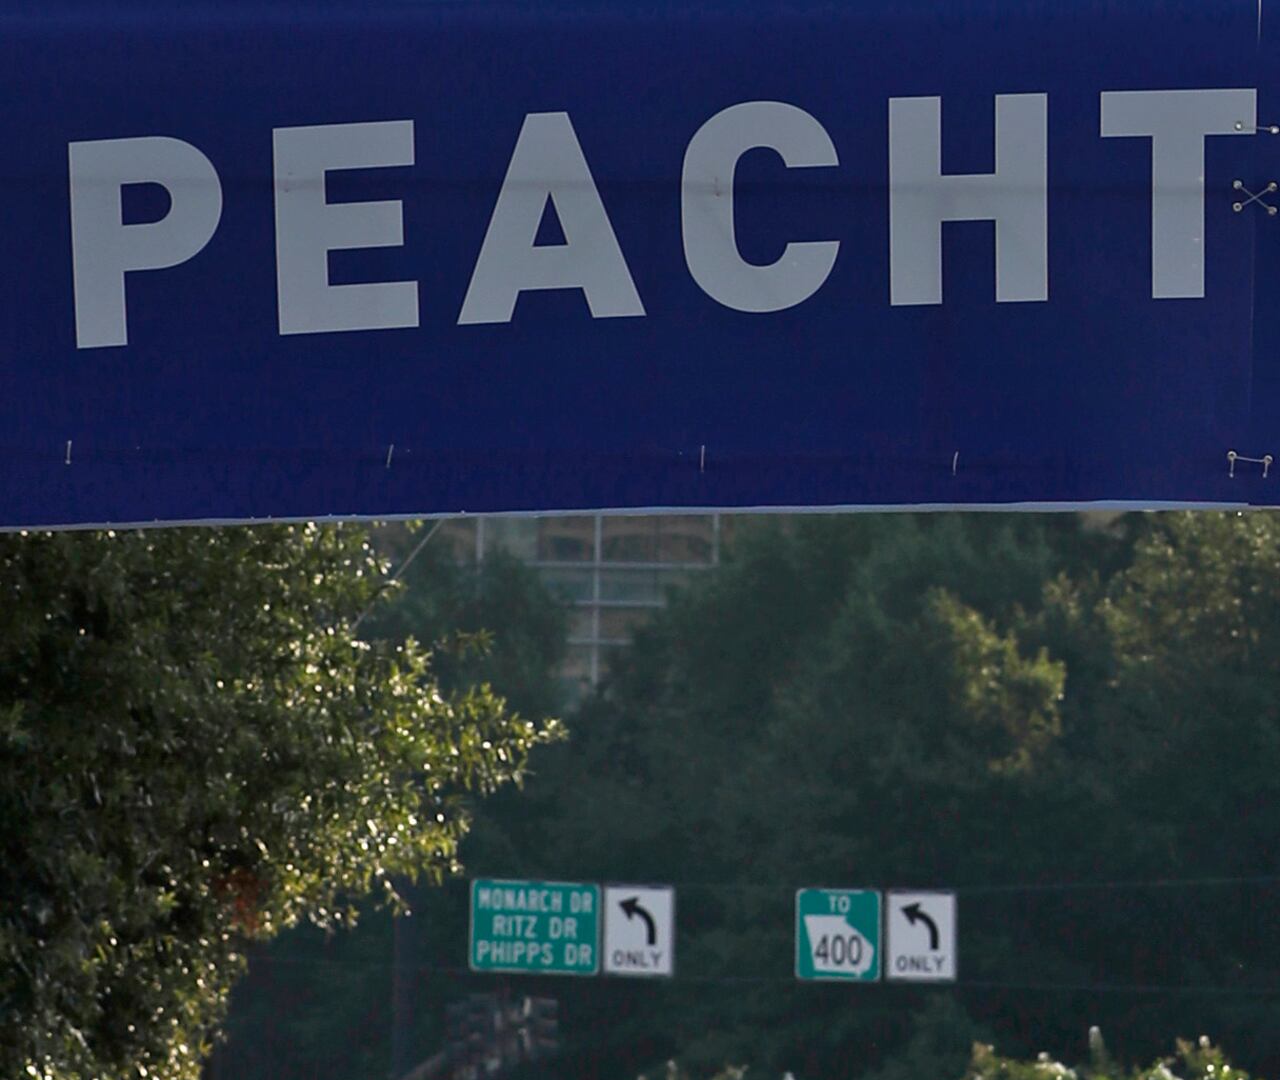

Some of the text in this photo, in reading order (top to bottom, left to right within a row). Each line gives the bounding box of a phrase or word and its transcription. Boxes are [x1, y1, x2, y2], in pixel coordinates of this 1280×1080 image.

[478, 888, 593, 913] MONARCH DR
[829, 896, 850, 913] TO
[493, 915, 577, 939] RITZ DR
[476, 940, 592, 965] PHIPPS DR
[612, 951, 662, 967] ONLY
[815, 934, 863, 966] 400
[896, 956, 945, 972] ONLY
